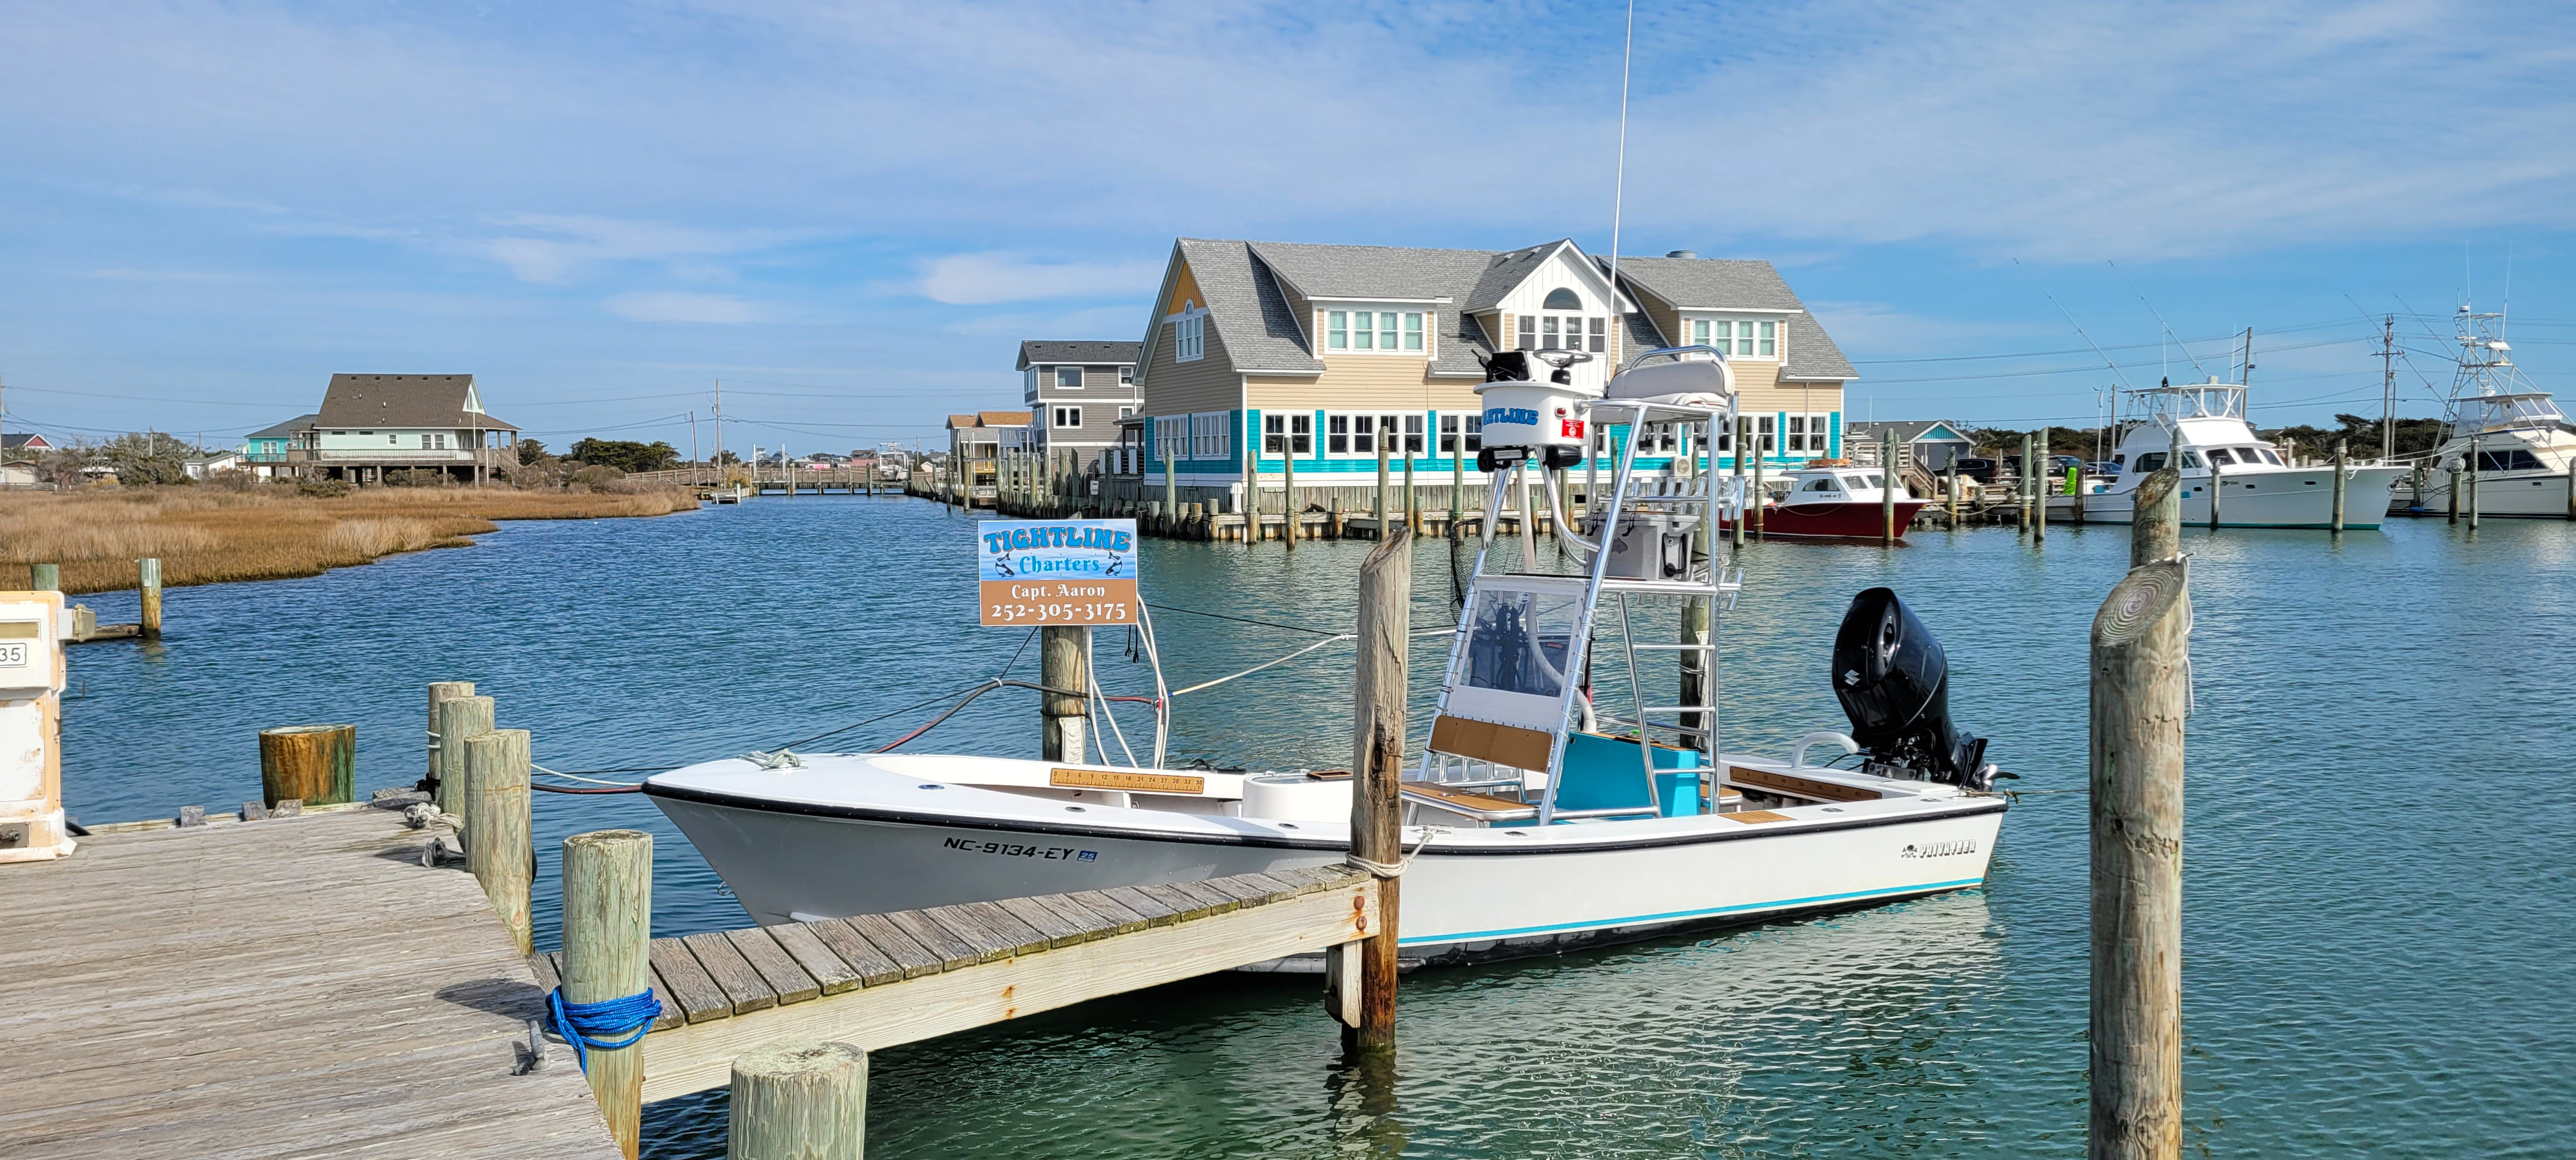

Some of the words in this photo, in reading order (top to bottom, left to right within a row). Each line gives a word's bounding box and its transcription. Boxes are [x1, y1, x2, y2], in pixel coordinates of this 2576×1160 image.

[983, 526, 1131, 554] TIGHTLINE
[1019, 556, 1100, 574] Charters
[1011, 584, 1051, 600] Capt.
[1056, 584, 1105, 598] Aaron
[991, 602, 1126, 622] 252-305-3175
[944, 837, 1075, 860] NC-9134-EY
[1919, 839, 1976, 859] PRIVATEER
